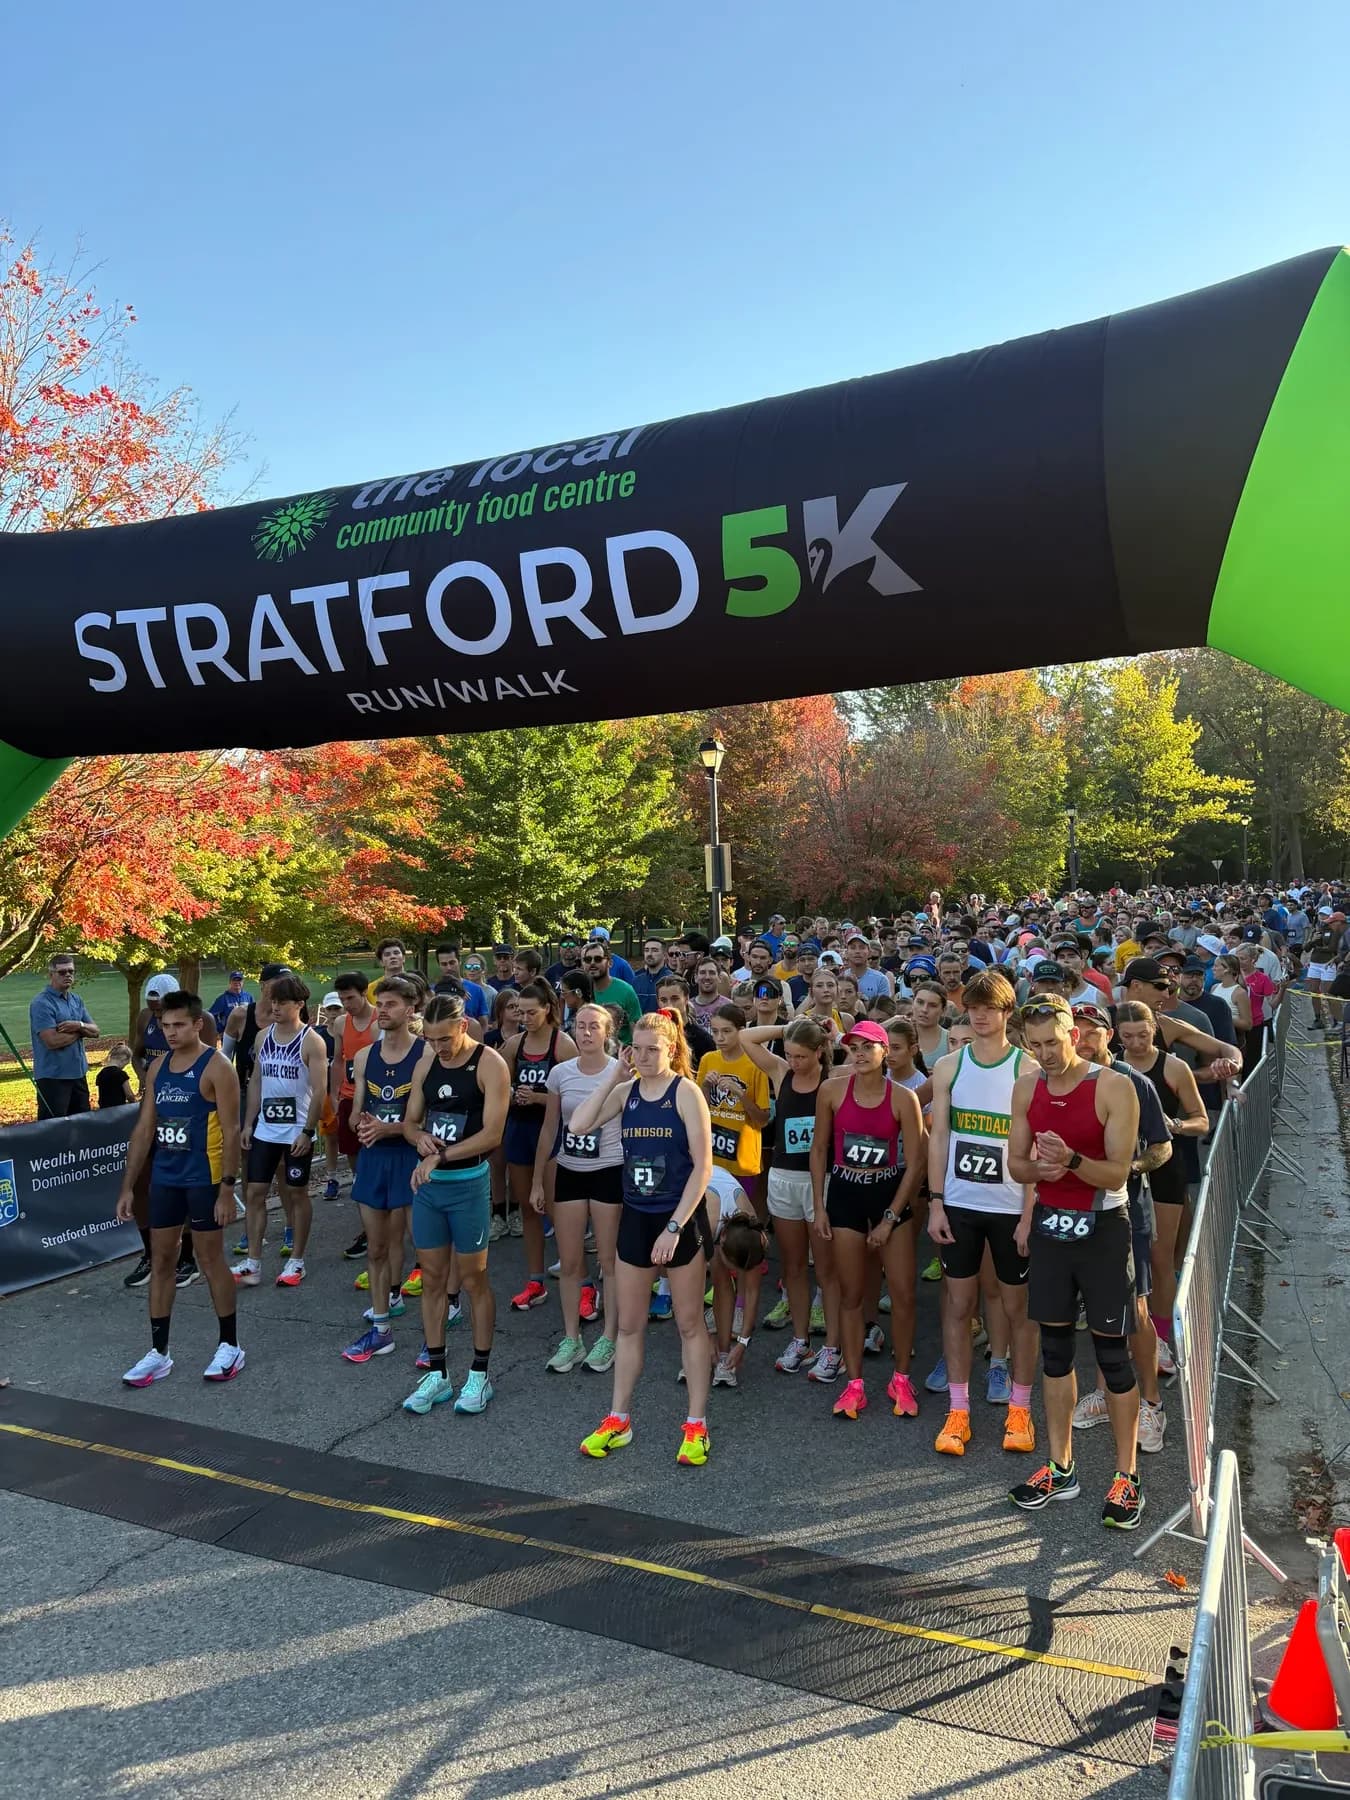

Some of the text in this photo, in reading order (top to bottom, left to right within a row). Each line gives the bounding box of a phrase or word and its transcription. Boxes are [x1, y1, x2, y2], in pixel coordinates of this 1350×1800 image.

[352, 426, 648, 510] the local
[336, 470, 636, 549] community food centre
[74, 482, 925, 692] STRATFORD 5K
[346, 669, 580, 714] RUN/WALK
[281, 1065, 300, 1080] CREEK
[519, 1069, 546, 1084] 602
[266, 1105, 294, 1118] 632
[156, 1127, 187, 1144] 386
[432, 1121, 457, 1142] M2
[566, 1132, 596, 1151] 533
[623, 1127, 673, 1138] WINDSOR
[29, 1151, 76, 1173] Wealth
[846, 1145, 885, 1165] 477
[959, 1153, 998, 1176] 672
[32, 1167, 90, 1192] Dominion
[634, 1168, 654, 1186] F1
[840, 1169, 872, 1184] NIKE
[1042, 1213, 1090, 1236] 496
[41, 1225, 88, 1249] Stratford
